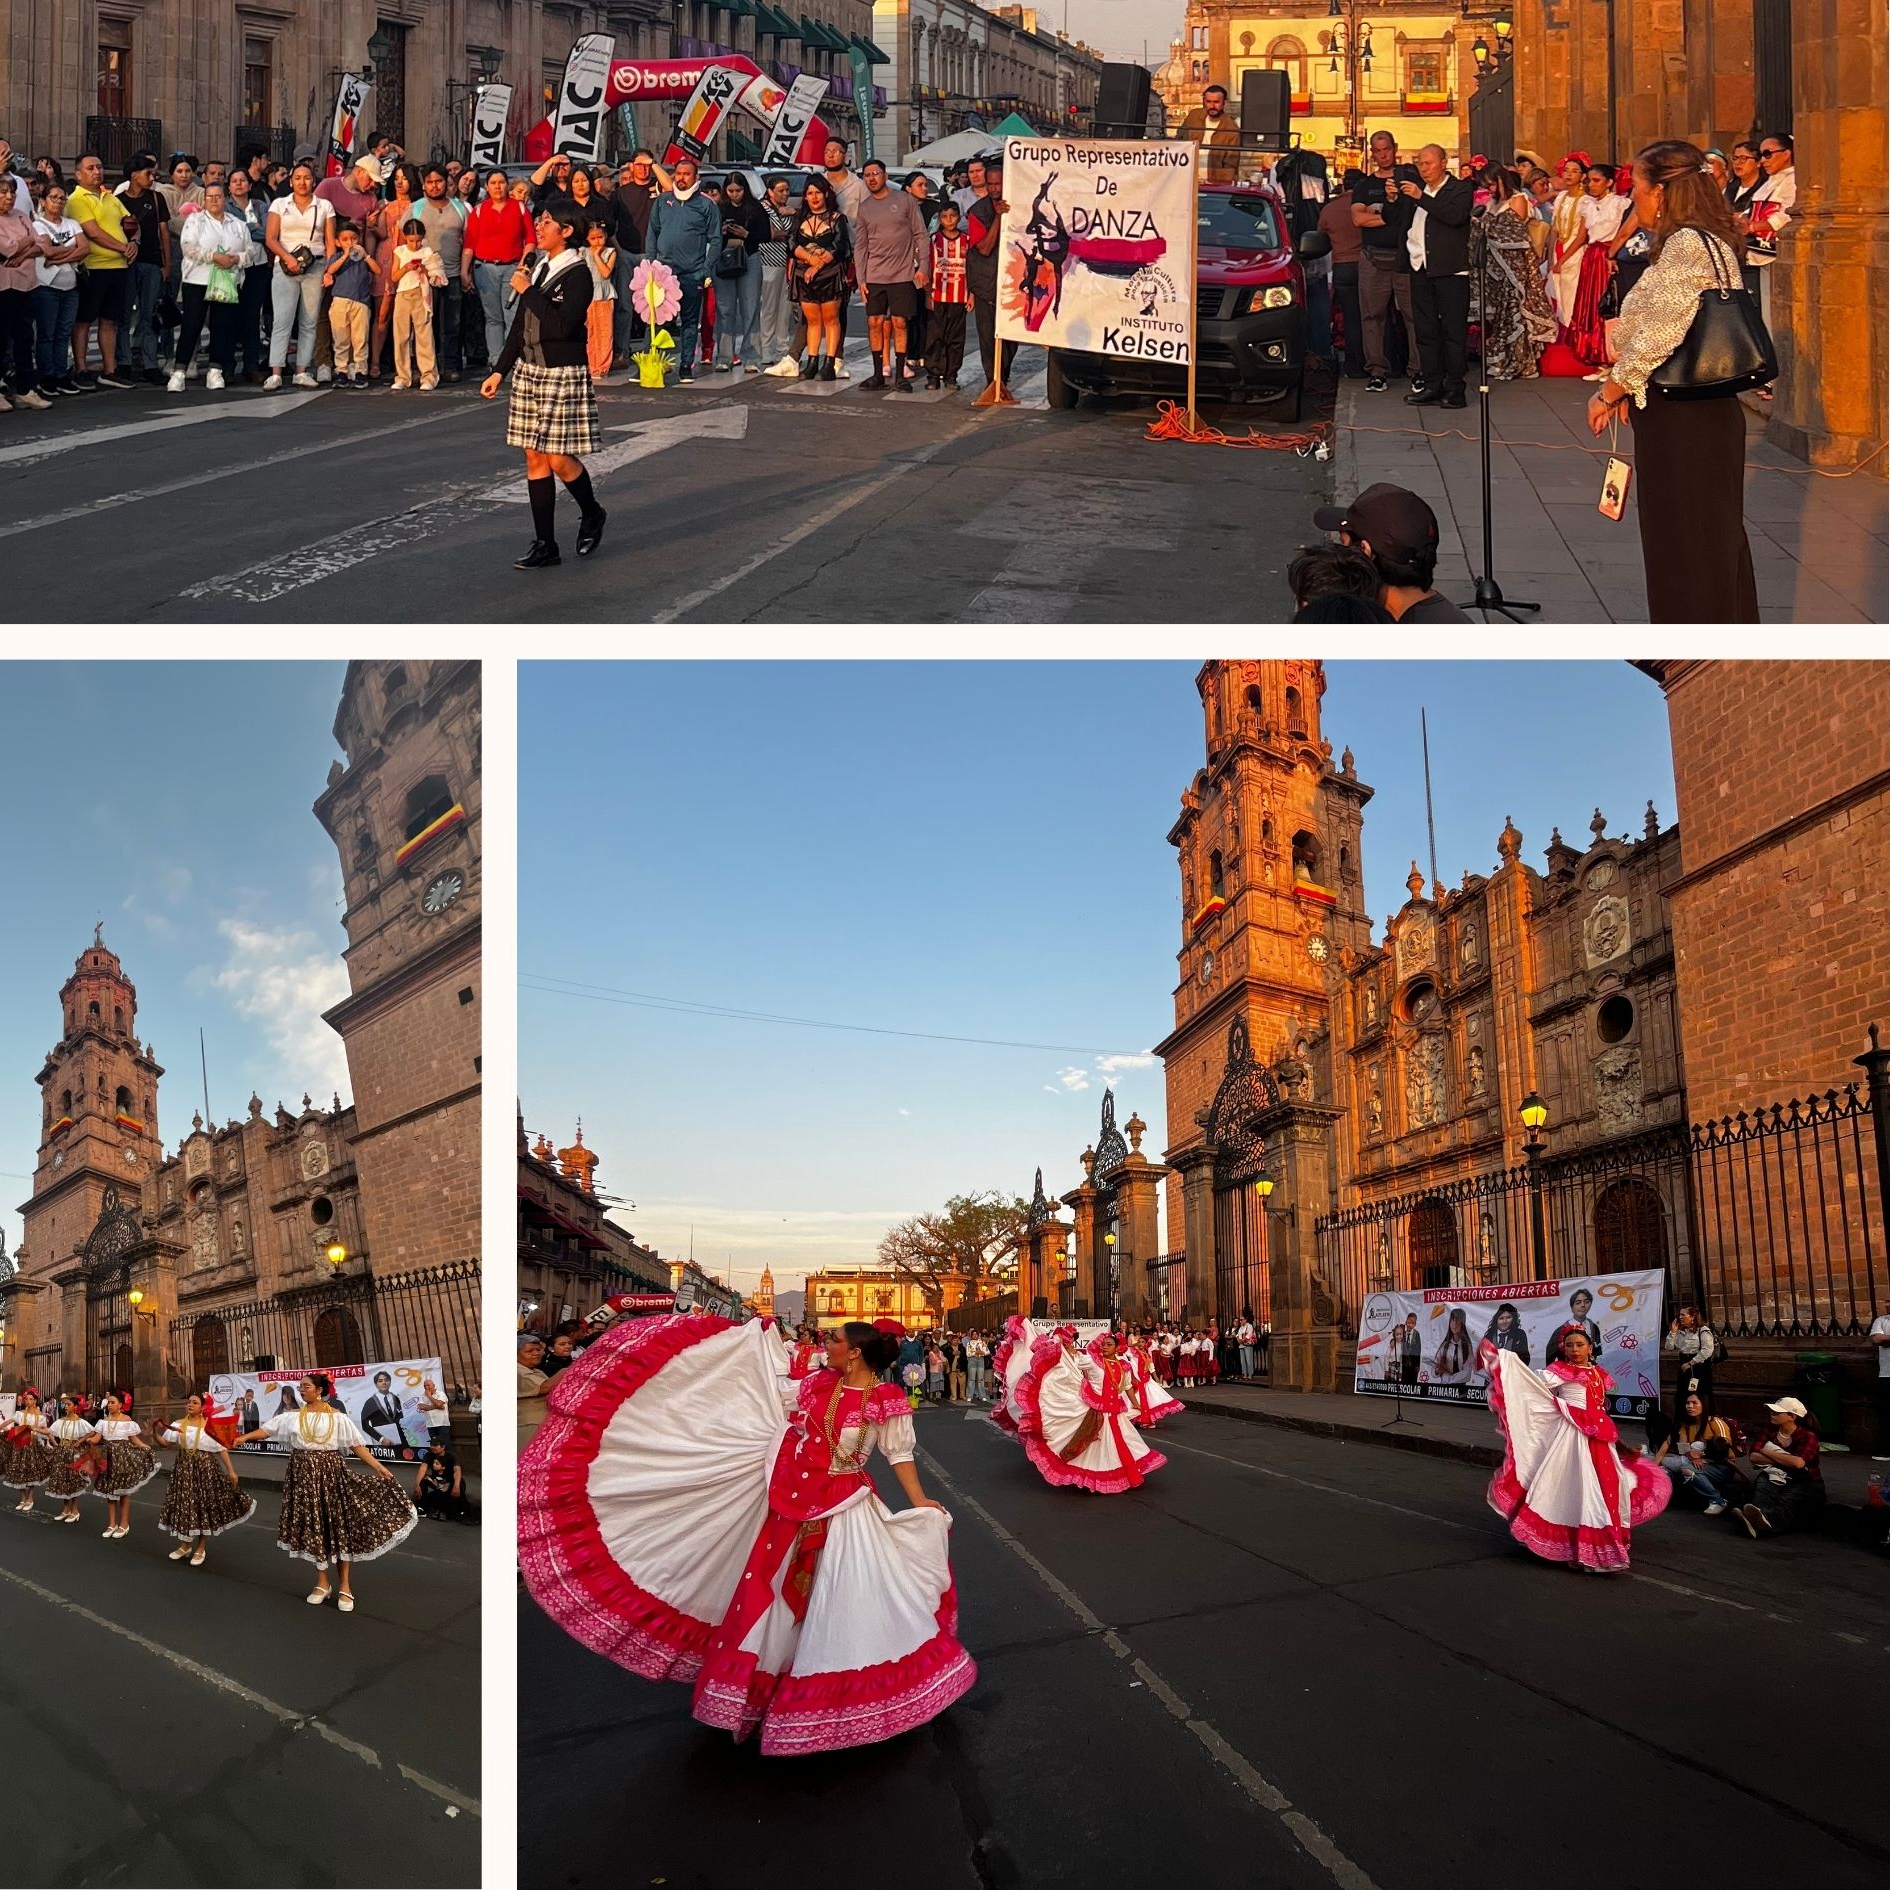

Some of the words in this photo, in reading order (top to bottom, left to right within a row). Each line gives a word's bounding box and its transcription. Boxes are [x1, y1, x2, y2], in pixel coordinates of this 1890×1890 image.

[644, 68, 705, 88] brem
[473, 119, 503, 166] AC
[1009, 141, 1060, 167] Grupo
[1065, 144, 1189, 169] Representativo
[1096, 176, 1118, 196] De
[1072, 206, 1160, 239] DANZA
[1154, 266, 1177, 303] Cultura
[1121, 316, 1184, 333] INSTITUTO
[1102, 326, 1189, 361] Kelsen
[635, 1297, 674, 1307] bremb
[1427, 1289, 1498, 1302] INSCRIPCIONES
[1501, 1283, 1557, 1298] ABIERTAS
[1032, 1320, 1055, 1328] Grupo
[1428, 1386, 1460, 1398] PRIMARIA
